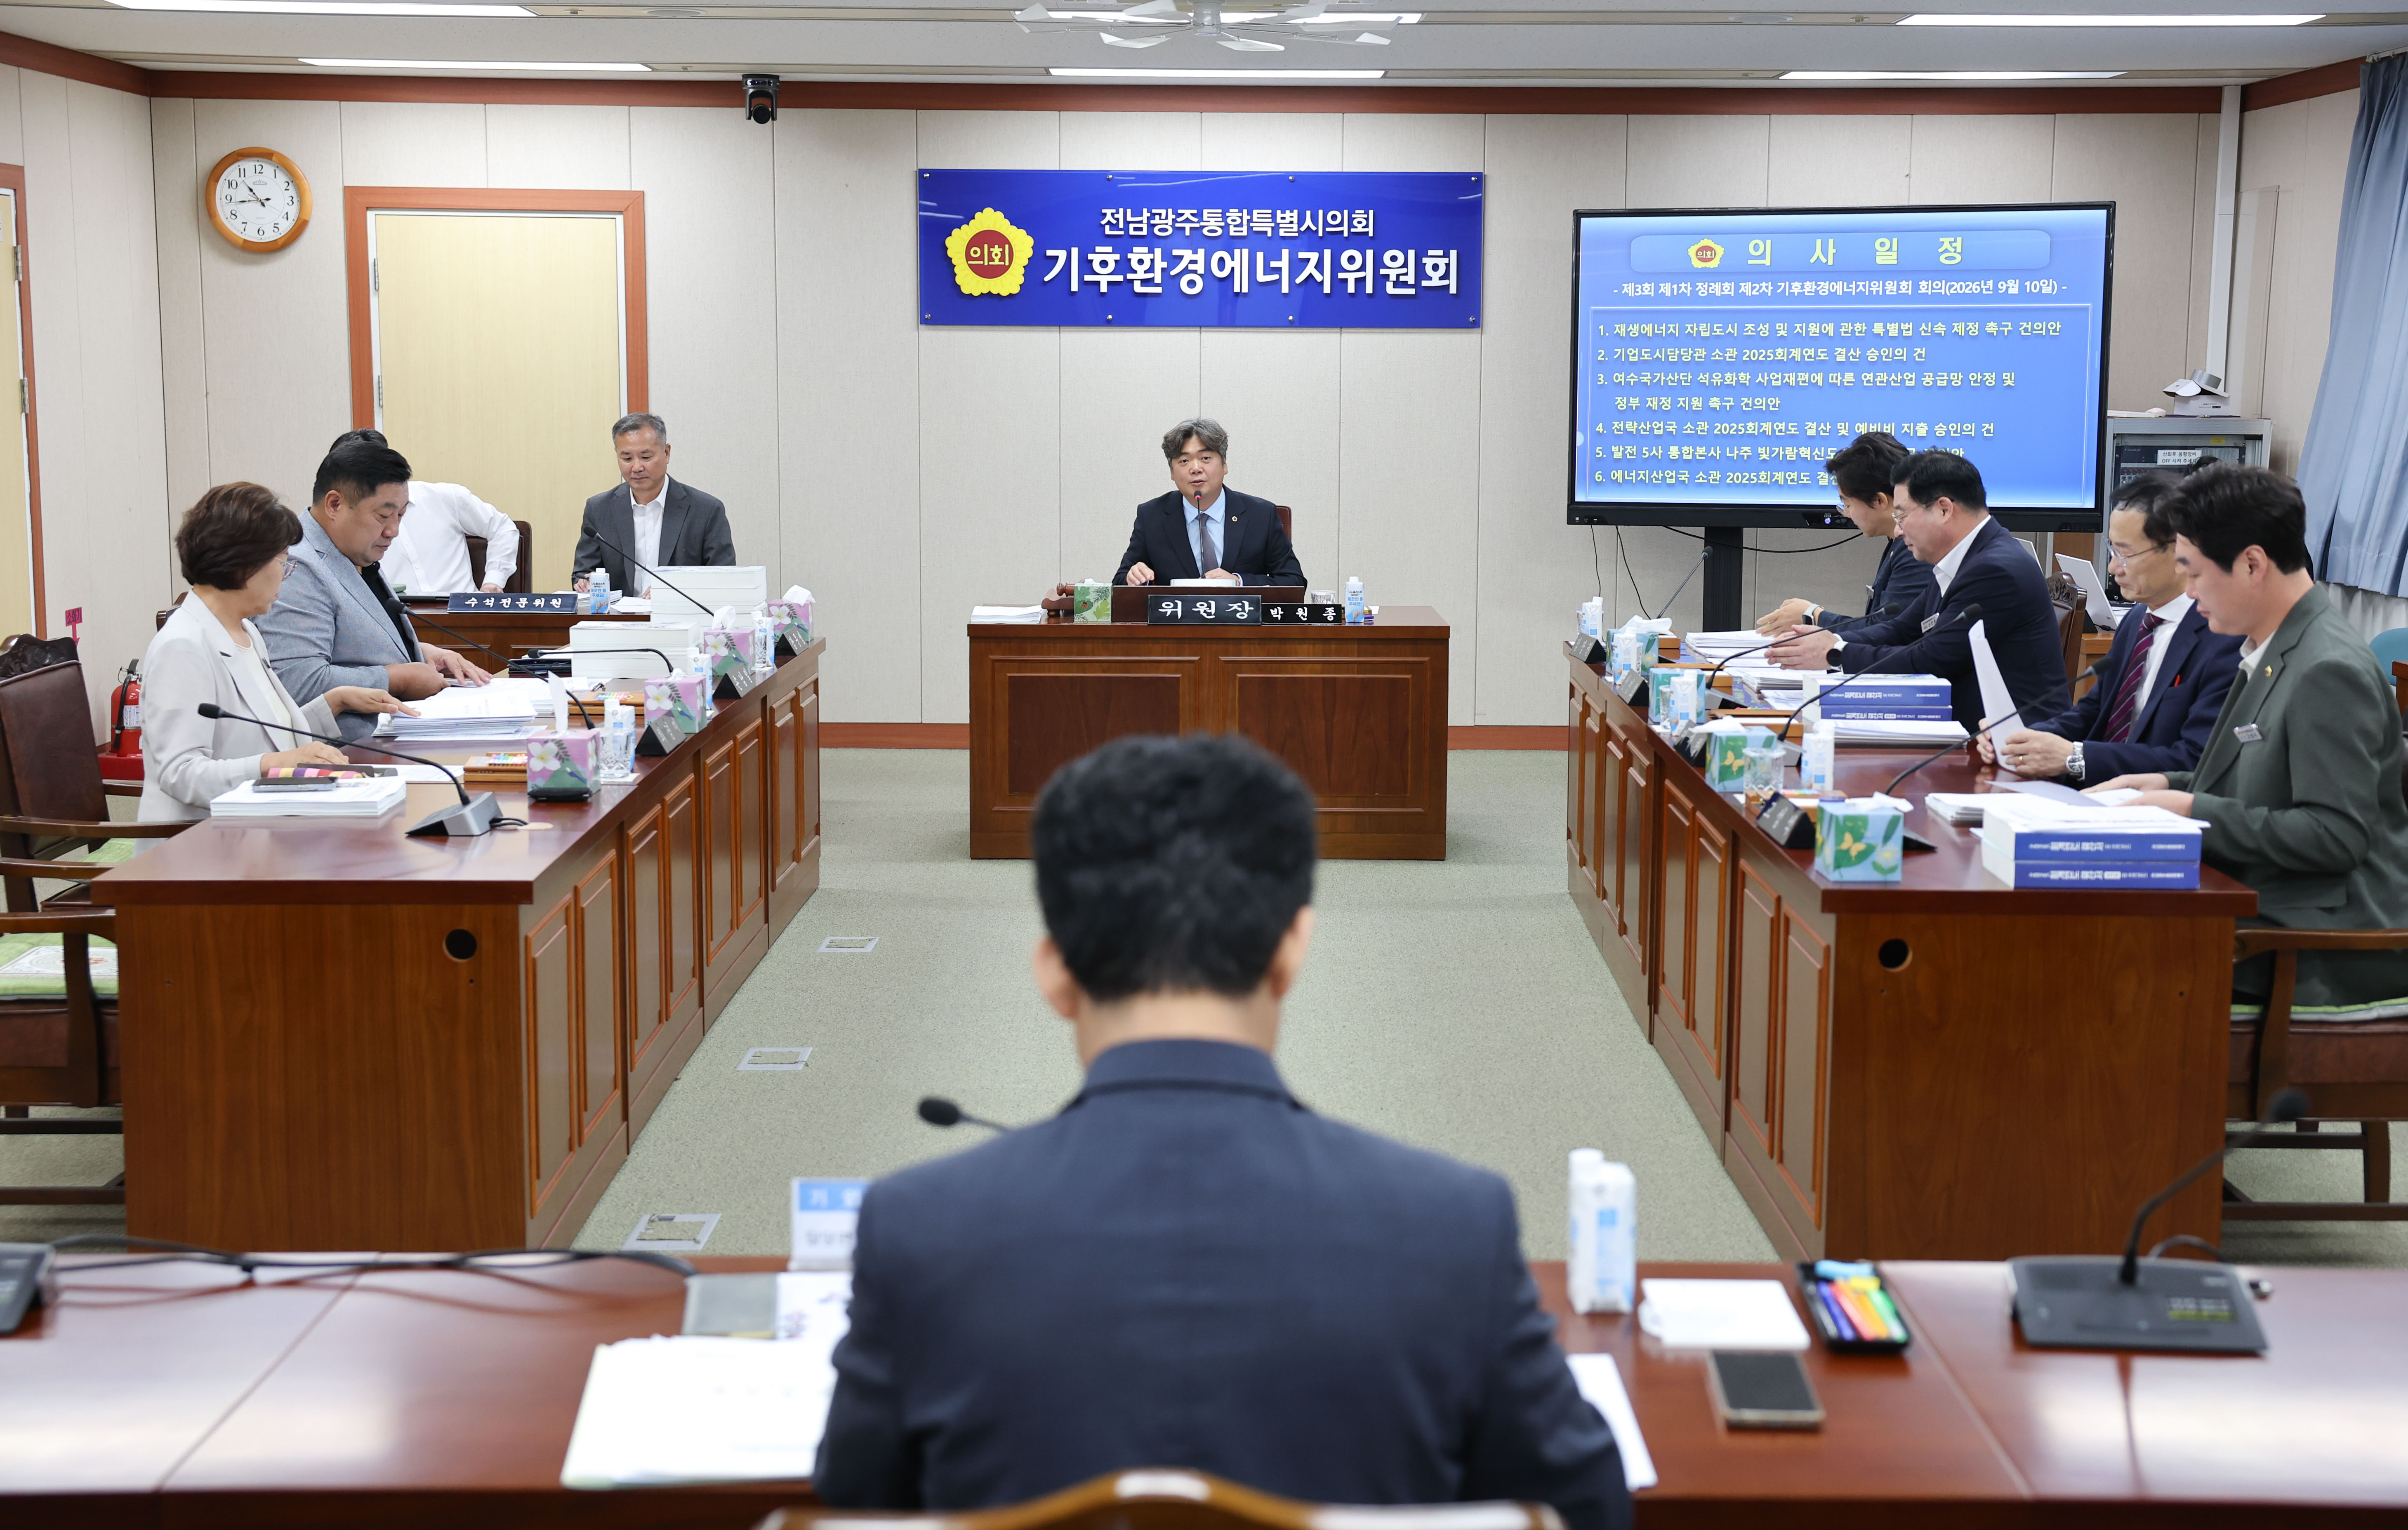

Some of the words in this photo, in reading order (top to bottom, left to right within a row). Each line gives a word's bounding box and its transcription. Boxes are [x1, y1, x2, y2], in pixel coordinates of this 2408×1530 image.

[238, 168, 246, 178] 11
[254, 165, 263, 174] 12
[273, 169, 276, 178] 1
[228, 179, 238, 190] 10
[284, 181, 290, 191] 2
[225, 194, 232, 203] 9
[287, 196, 294, 206] 3
[230, 209, 237, 220] 8
[282, 212, 289, 221] 4
[242, 222, 247, 232] 7
[273, 223, 279, 233] 5
[1100, 208, 1374, 238] 전남광주통합특별시의회
[257, 226, 264, 236] 6
[967, 243, 1010, 266] 의회
[1696, 250, 1715, 258] 의회
[1748, 239, 1772, 266] 의
[1810, 238, 1836, 265] 사
[1874, 237, 1898, 264] 일
[1937, 236, 1963, 265] 정
[1043, 247, 1457, 295] 기후환경에너지위원회
[1621, 282, 1654, 297] 제3회
[1658, 282, 1692, 297] 제1차
[1695, 281, 1734, 297] 정례회
[1739, 281, 1774, 297] 제2차
[1777, 280, 1912, 296] 기후환경에너지위원회
[1918, 279, 1993, 296] 회의(2026년
[1998, 279, 2019, 294] 9월
[2024, 279, 2058, 295] 10일)
[1599, 325, 1609, 336] 1.
[1614, 323, 1679, 337] 재생에너지
[1685, 322, 1737, 337] 자립도시
[1743, 322, 1769, 337] 조성
[1776, 322, 1788, 337] 및
[1793, 322, 1834, 337] 지원에
[1839, 322, 1867, 336] 관한
[1872, 322, 1913, 337] 특별법
[1919, 322, 1946, 336] 신속
[1951, 322, 1979, 336] 제정
[1985, 321, 2013, 336] 촉구
[2019, 321, 2062, 336] 건의안
[1597, 349, 1608, 360] 2.
[1613, 347, 1707, 362] 기업도시담당관
[1711, 347, 1738, 361] 소관
[1742, 347, 1829, 362] 2025회계연도
[1834, 347, 1861, 362] 결산
[1866, 347, 1907, 362] 승인의
[1913, 347, 1925, 361] 건
[1597, 373, 1608, 385] 3.
[1613, 372, 1692, 386] 여수국가산단
[1697, 372, 1751, 386] 석유화학
[1755, 372, 1823, 386] 사업재편에
[1828, 372, 1856, 386] 따른
[1861, 372, 1916, 386] 연관산업
[1921, 372, 1964, 386] 공급망
[1968, 372, 1996, 386] 안정
[2003, 372, 2015, 386] 및
[1615, 396, 1641, 410] 정부
[1645, 396, 1671, 410] 재정
[1677, 396, 1702, 411] 지원
[1708, 396, 1735, 411] 촉구
[1740, 397, 1781, 411] 건의안
[1595, 422, 1607, 433] 4.
[1612, 421, 1678, 435] 전략산업국
[1682, 421, 1709, 435] 소관
[1713, 421, 1800, 436] 2025회계연도
[1804, 422, 1832, 436] 결산
[1837, 422, 1849, 436] 및
[1855, 422, 1895, 436] 예비비
[1901, 422, 1929, 437] 지출
[1934, 422, 1975, 437] 승인의
[1981, 422, 1993, 437] 건
[1595, 447, 1606, 458] 5.
[1612, 445, 1636, 459] 발전
[1642, 445, 1663, 459] 5사
[1667, 445, 1721, 460] 통합본사
[1726, 446, 1752, 460] 나주
[1595, 471, 1606, 482] 6.
[1611, 469, 1690, 484] 에너지산업국
[1694, 470, 1722, 484] 소관
[1726, 471, 1812, 485] 2025회계연도
[464, 597, 562, 608] 수석전문위원
[1158, 600, 1254, 619] 위원장
[67, 609, 81, 624] 소화기
